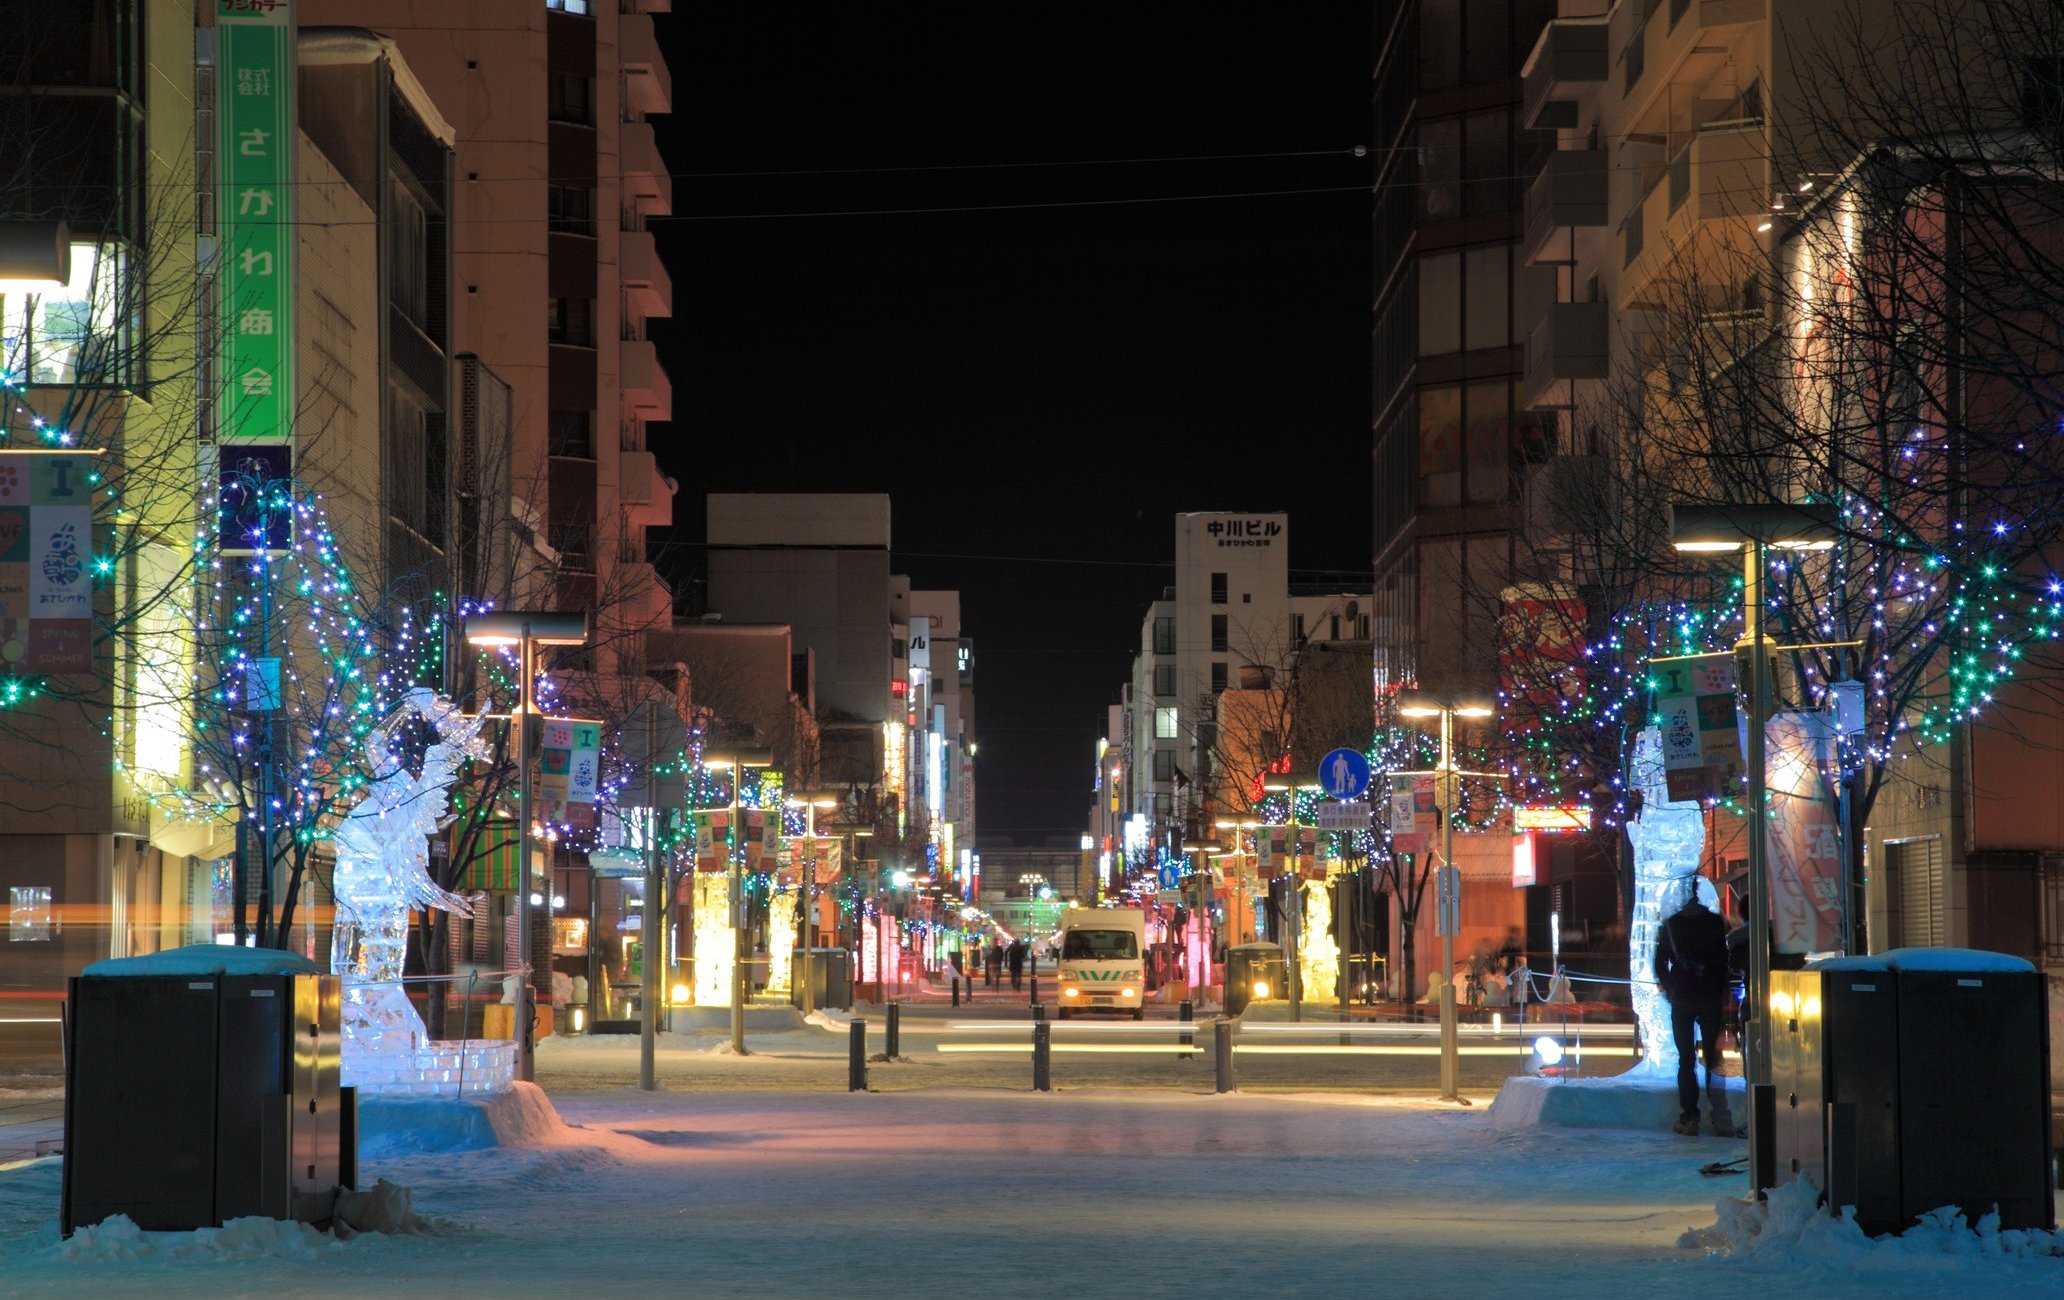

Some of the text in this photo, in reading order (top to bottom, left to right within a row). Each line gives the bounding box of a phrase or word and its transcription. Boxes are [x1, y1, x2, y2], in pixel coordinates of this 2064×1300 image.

[239, 128, 273, 395] さかわ商会
[1207, 520, 1281, 537] 中川ビル
